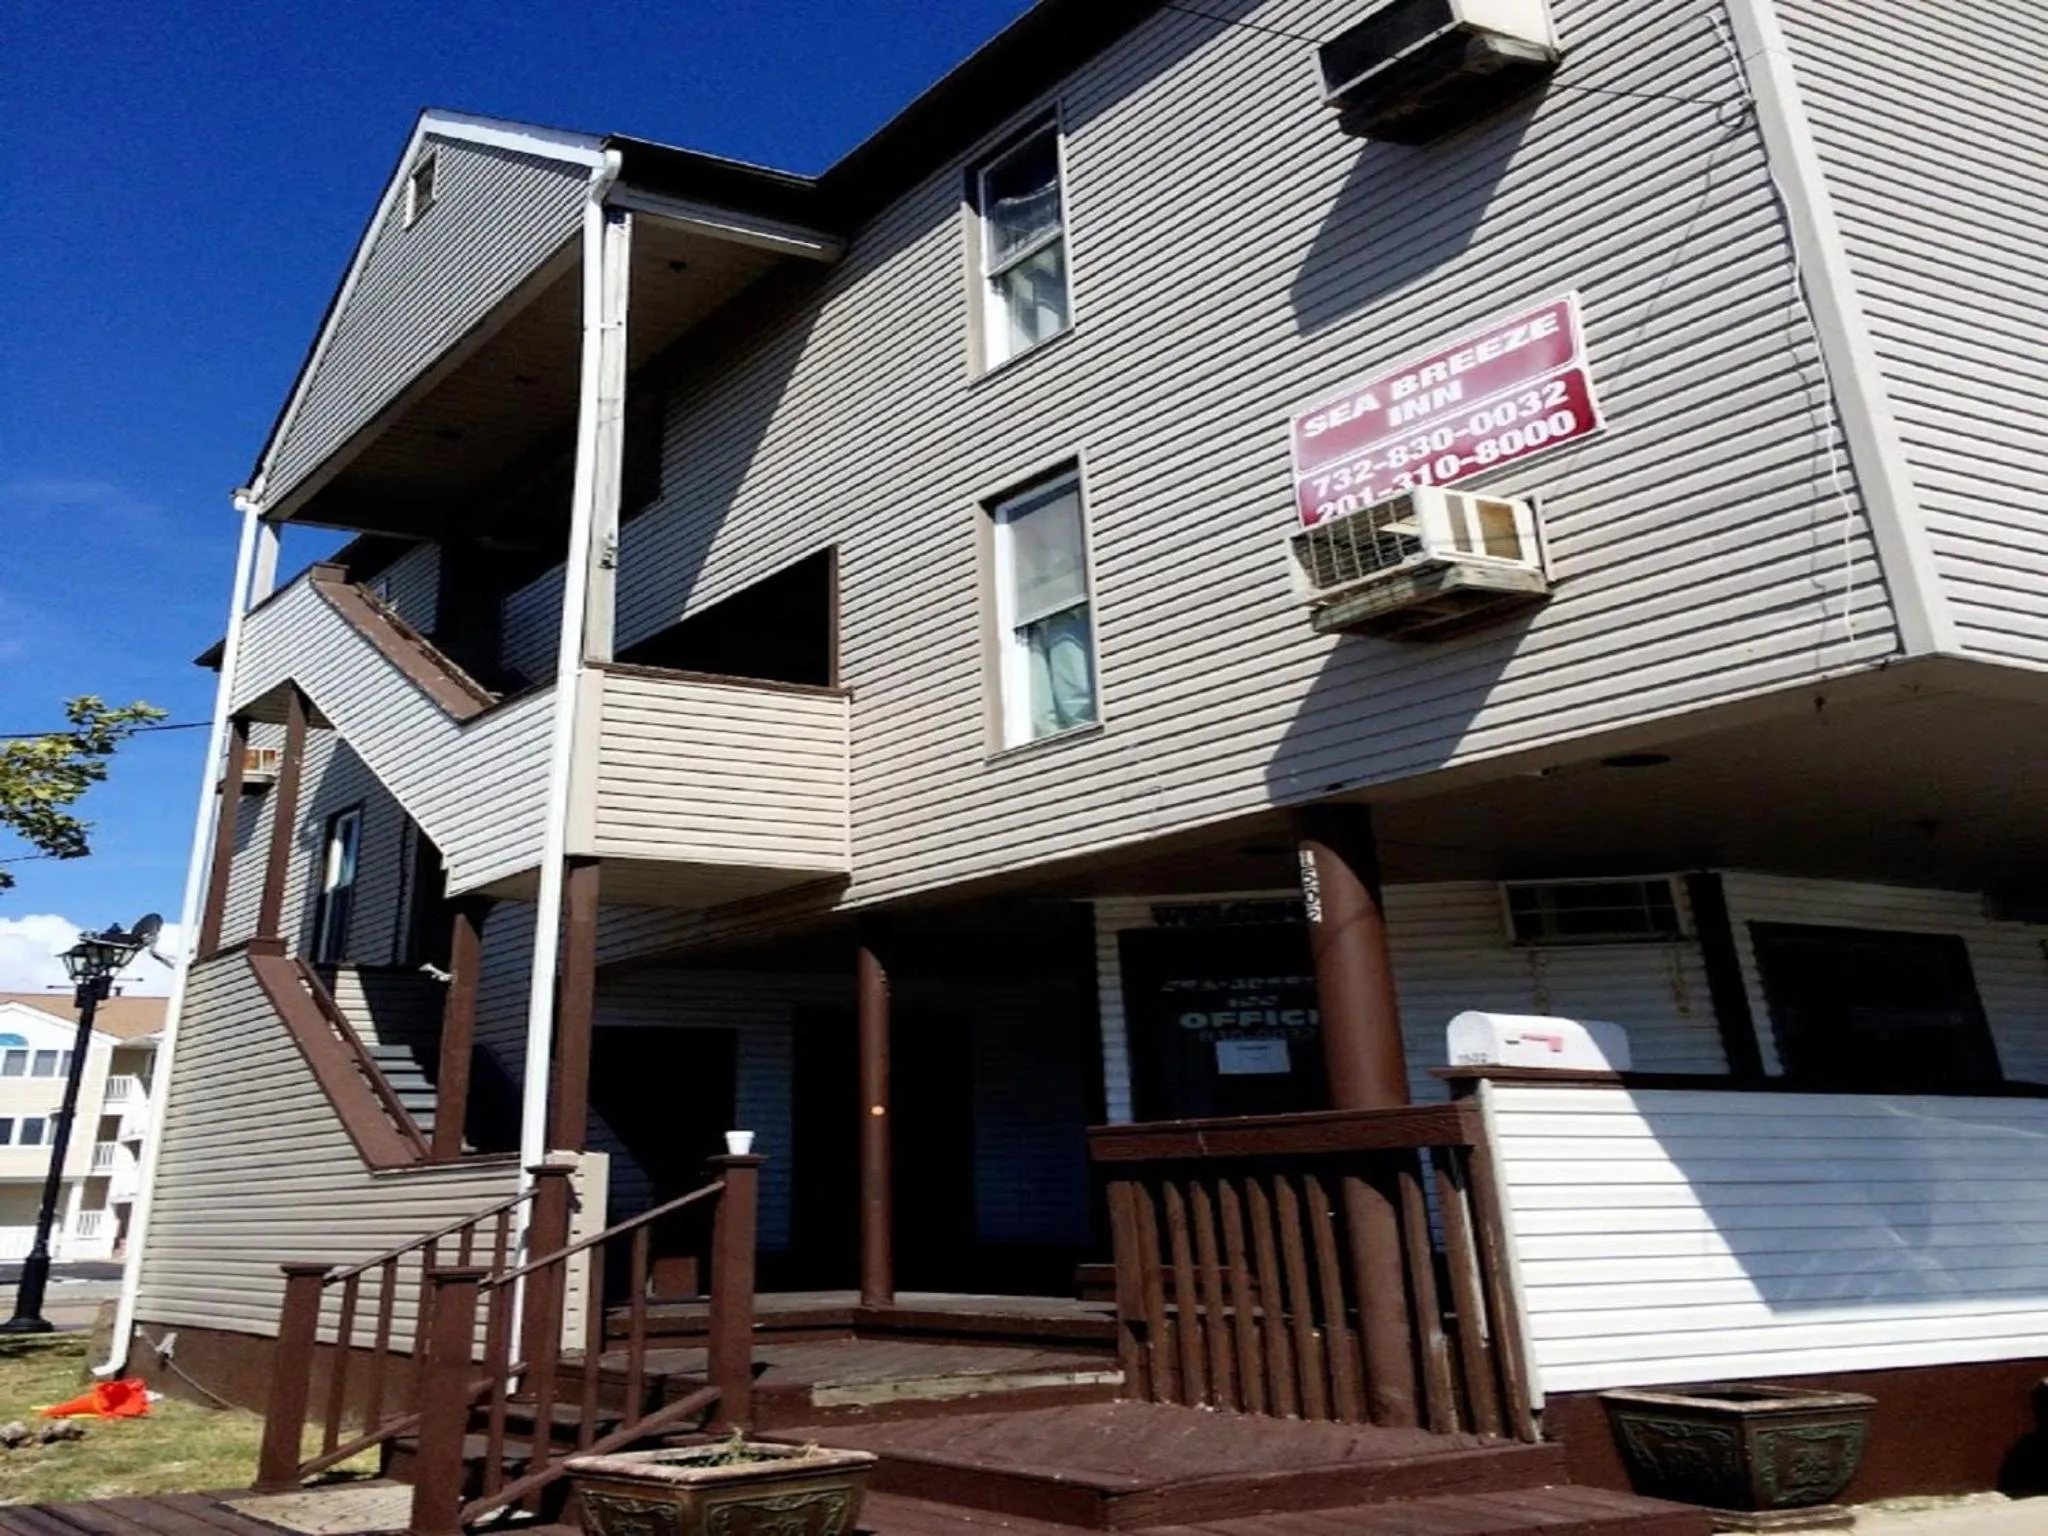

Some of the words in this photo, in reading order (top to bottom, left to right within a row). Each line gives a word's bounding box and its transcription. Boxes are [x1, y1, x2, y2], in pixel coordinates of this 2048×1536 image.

[1303, 394, 1380, 437] SEA
[1389, 312, 1560, 400] BREEZE
[1386, 380, 1463, 427] INN
[1312, 380, 1569, 498] 732-830-0032
[1315, 409, 1577, 524] 201-310-8000
